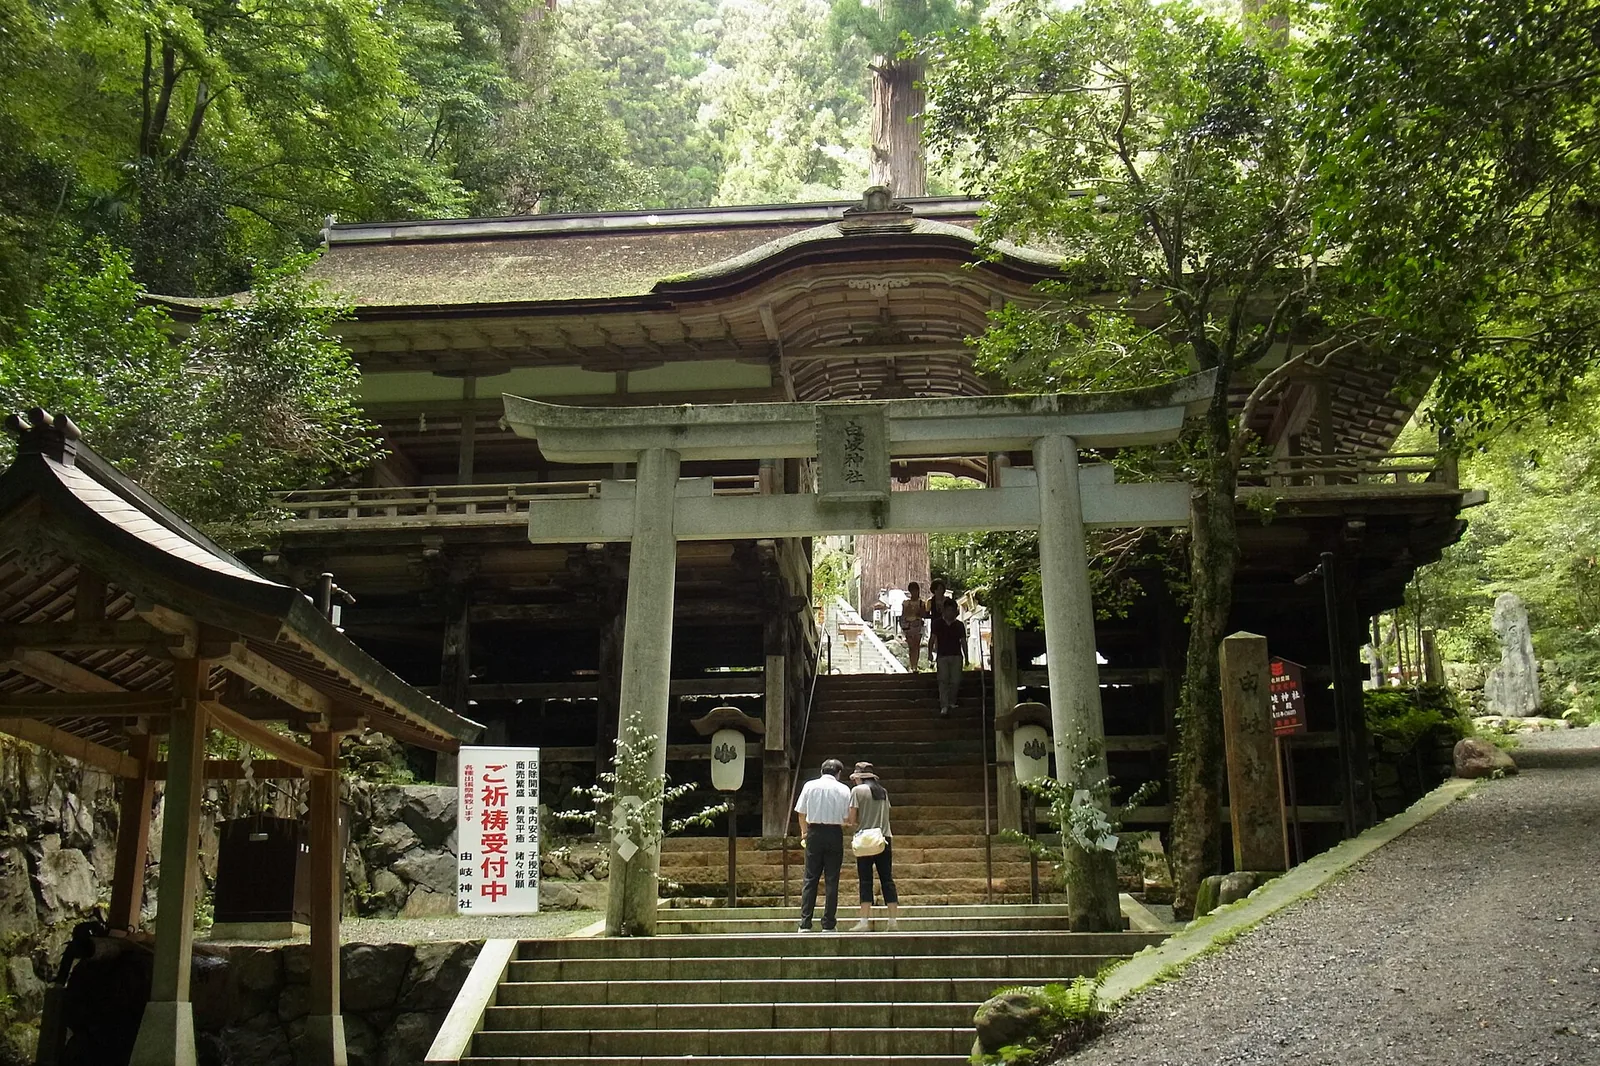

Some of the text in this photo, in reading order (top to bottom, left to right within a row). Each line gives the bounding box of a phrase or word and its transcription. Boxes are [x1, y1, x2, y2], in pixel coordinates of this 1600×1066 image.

[458, 851, 473, 909] 由岐神社
[480, 764, 509, 903] ご祈祷受付中
[515, 761, 525, 889] 商売繁盛 病気平癒 諸々祈願
[527, 761, 538, 888] 厄除開運 家内安全 子授安産
